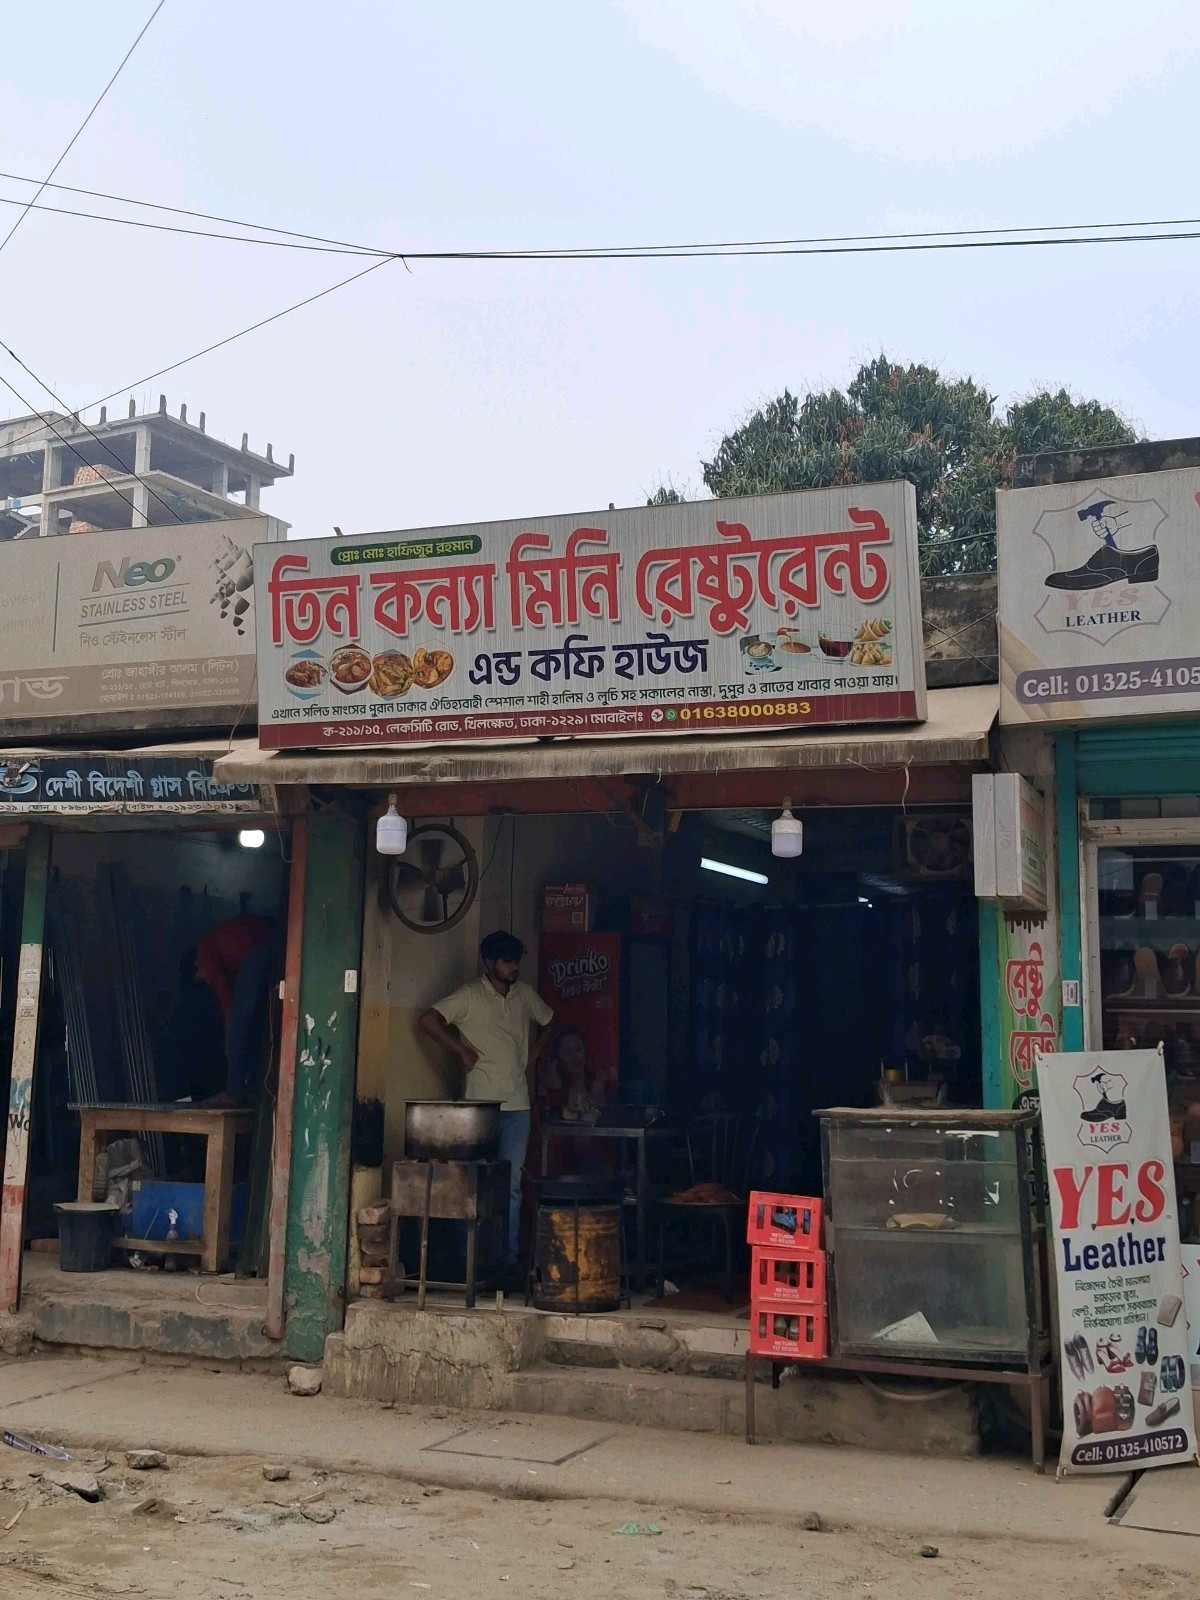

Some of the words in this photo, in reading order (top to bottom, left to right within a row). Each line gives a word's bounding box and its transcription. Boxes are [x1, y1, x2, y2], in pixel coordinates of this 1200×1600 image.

[387, 543, 434, 558] হাফিজুর
[436, 540, 474, 553] রহমান
[92, 556, 176, 593] Neo
[268, 554, 361, 644] তিন
[369, 563, 497, 635] কন্যা
[506, 528, 621, 628] মিনি
[636, 507, 892, 633] রেষ্টুরেন্ট
[81, 597, 146, 619] STAINLESS
[149, 590, 188, 608] STEEL
[1066, 588, 1139, 611] YES
[1066, 610, 1142, 627] LEATHER
[80, 632, 99, 647] নিও
[169, 663, 198, 675] আলম
[468, 650, 522, 686] এন্ড
[528, 633, 606, 682] কফি
[612, 632, 710, 681] হাউজ
[271, 708, 301, 719] এখানে
[303, 703, 330, 717] সলিড
[332, 704, 366, 716] মাংসের
[369, 702, 394, 717] পুরান
[396, 701, 427, 713] ঢাকার
[430, 694, 482, 710] ঐতিহ্যবাহী
[485, 697, 525, 708] স্পেশাল
[527, 691, 549, 706] শাহী
[552, 690, 584, 704] হালিম
[586, 693, 594, 702] ও
[597, 687, 619, 705] লুচি
[621, 690, 637, 701] সহ
[640, 687, 685, 699] সকালের
[718, 684, 745, 700] দুপুর
[748, 684, 757, 694] ও
[759, 681, 794, 693] রাতের
[798, 679, 831, 690] খাবার
[834, 676, 869, 690] পাওয়া
[1023, 675, 1069, 698] Cell:
[386, 718, 433, 734] লেকসিটি
[680, 701, 811, 720] 01638000883
[46, 770, 83, 797] দেশী
[86, 769, 145, 798] বিদেশী
[550, 948, 610, 984] Drinko
[1088, 1122, 1121, 1134] YES
[1090, 1134, 1122, 1143] LEATHER
[1053, 1160, 1166, 1229] YES
[1062, 1231, 1166, 1272] Leather
[1075, 1446, 1103, 1462] Cell:
[1106, 1434, 1183, 1459] 01325-410572
